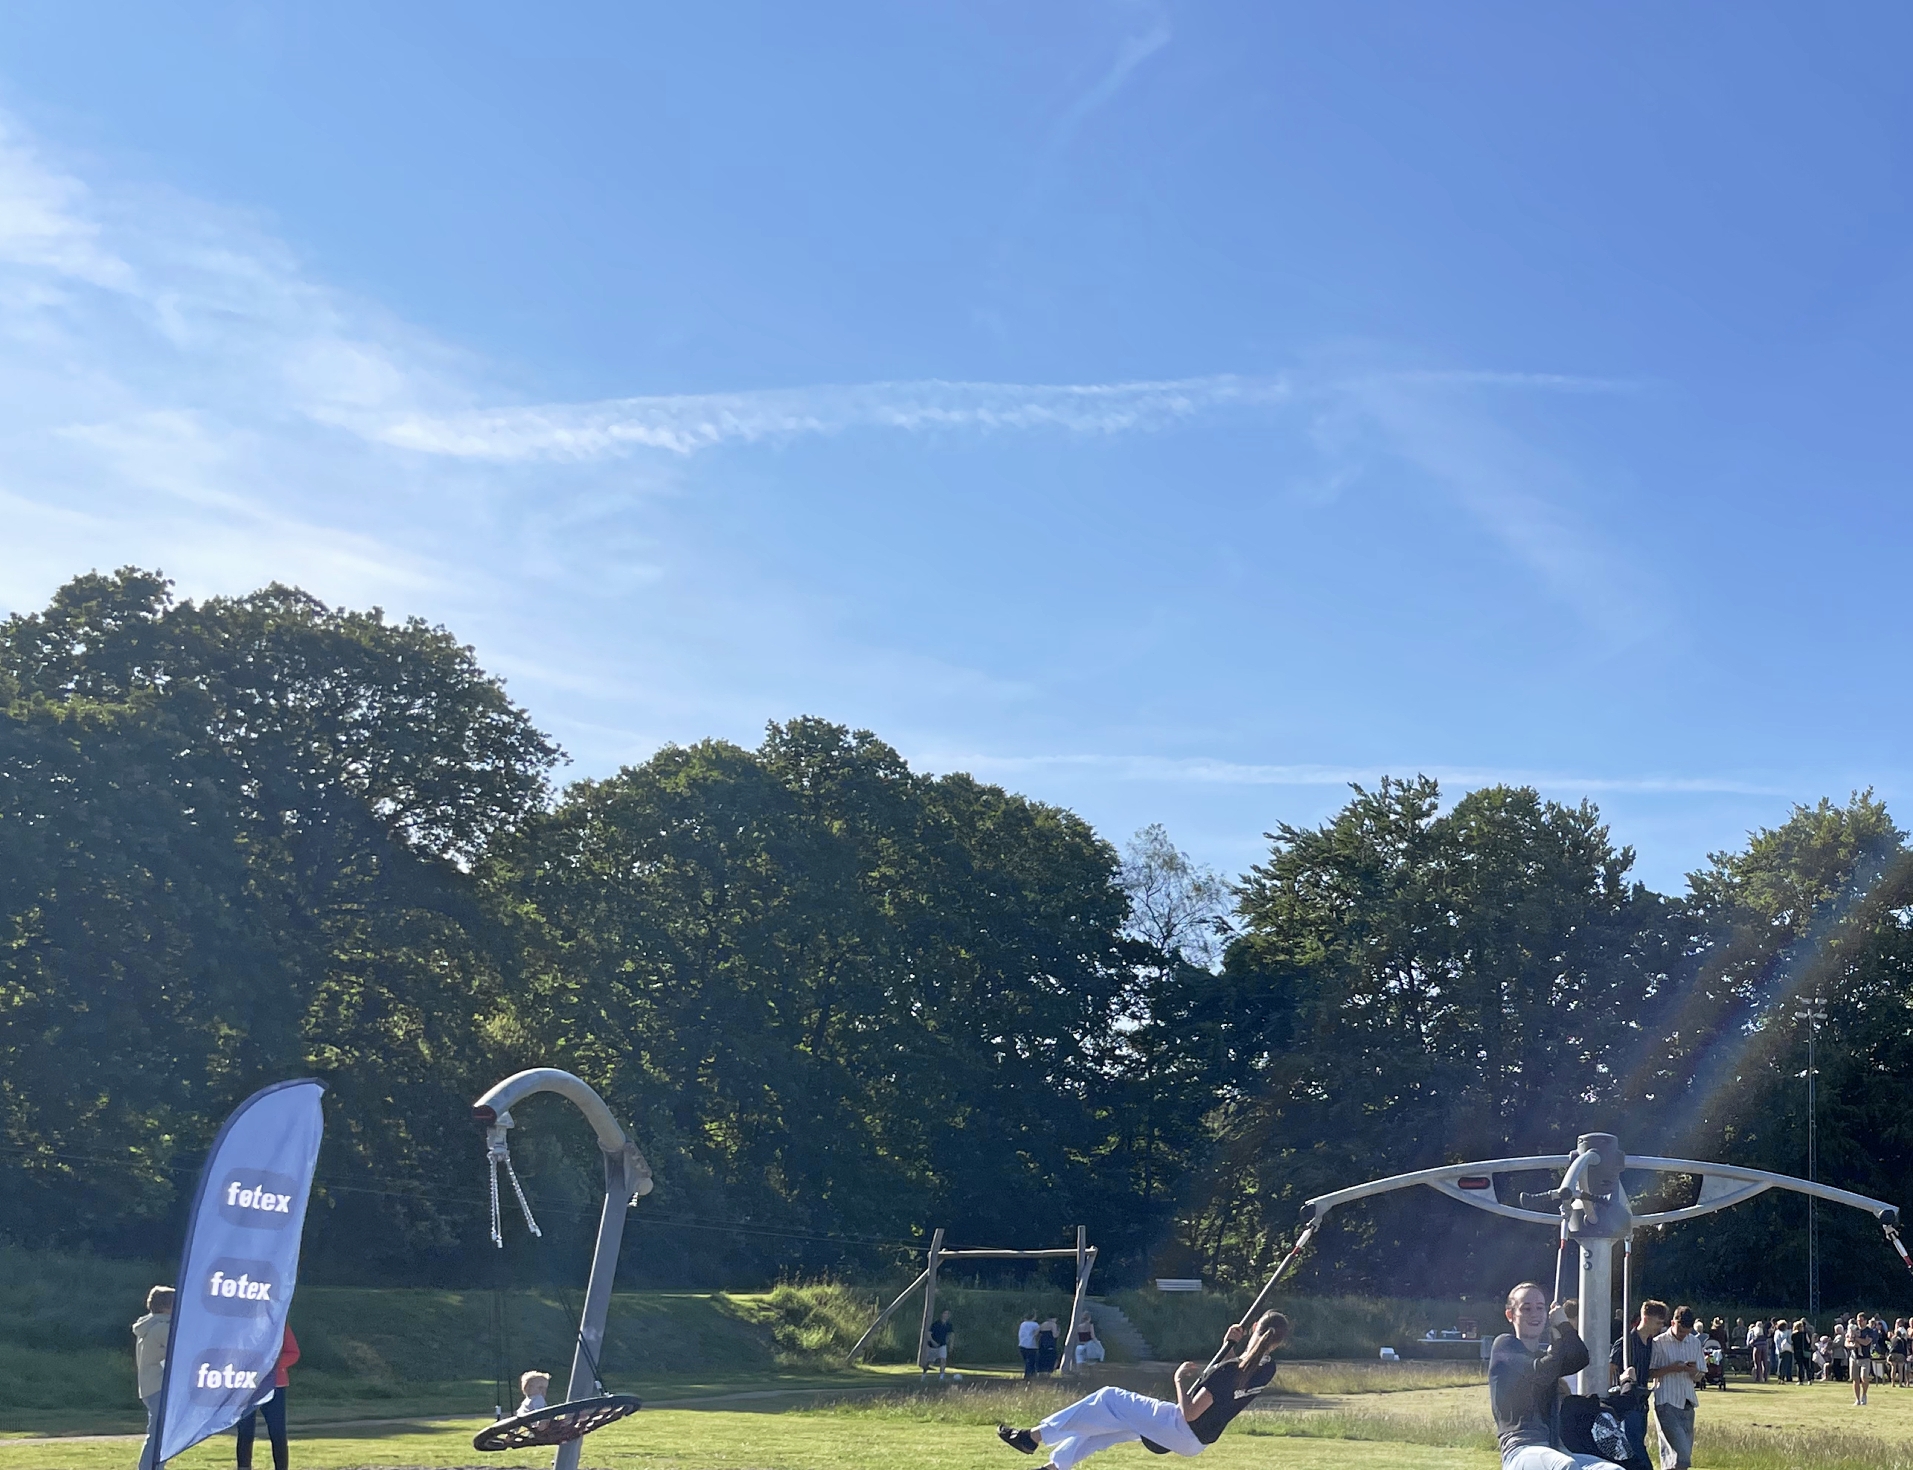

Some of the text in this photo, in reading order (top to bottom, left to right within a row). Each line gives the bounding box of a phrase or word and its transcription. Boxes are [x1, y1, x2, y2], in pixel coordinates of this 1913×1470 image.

[227, 1181, 292, 1213] føtex
[210, 1271, 271, 1300] føtex
[197, 1362, 257, 1388] føtex
